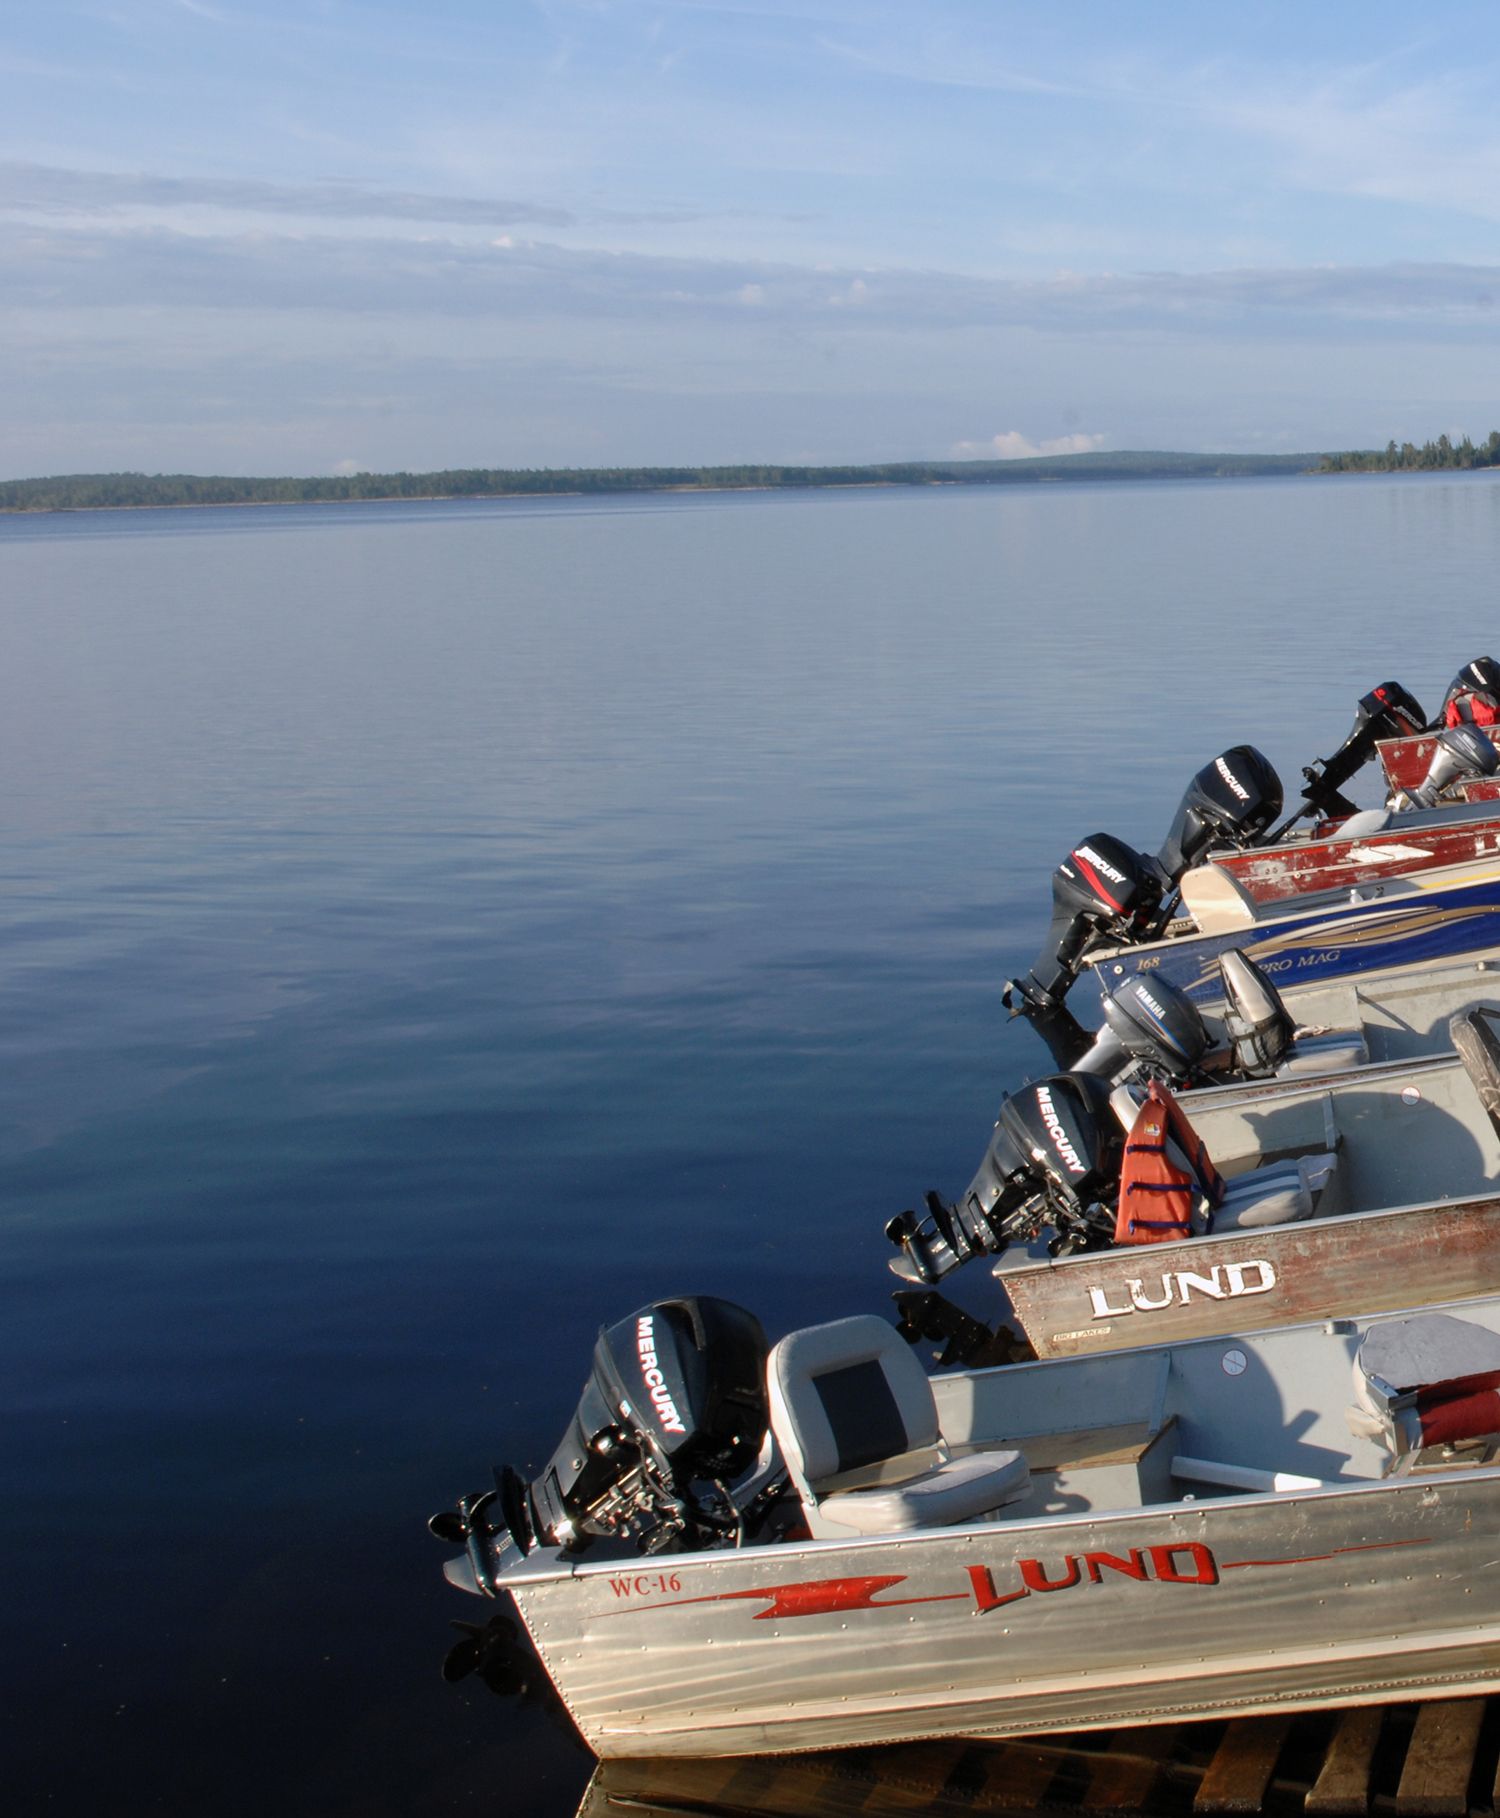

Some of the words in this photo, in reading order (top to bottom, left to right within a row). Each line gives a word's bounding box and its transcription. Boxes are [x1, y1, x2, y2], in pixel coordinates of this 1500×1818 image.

[1215, 756, 1250, 800] MERCURY
[1075, 845, 1127, 884] MERCURY
[1137, 956, 1160, 971] 168
[1297, 950, 1341, 967] MAG
[1136, 985, 1167, 1020] YAMAHA
[1036, 1086, 1087, 1173] MERCURY
[1085, 1259, 1277, 1321] LUND
[636, 1316, 687, 1434] MERCURY
[608, 1571, 682, 1598] WC-16
[963, 1541, 1220, 1616] LUND
